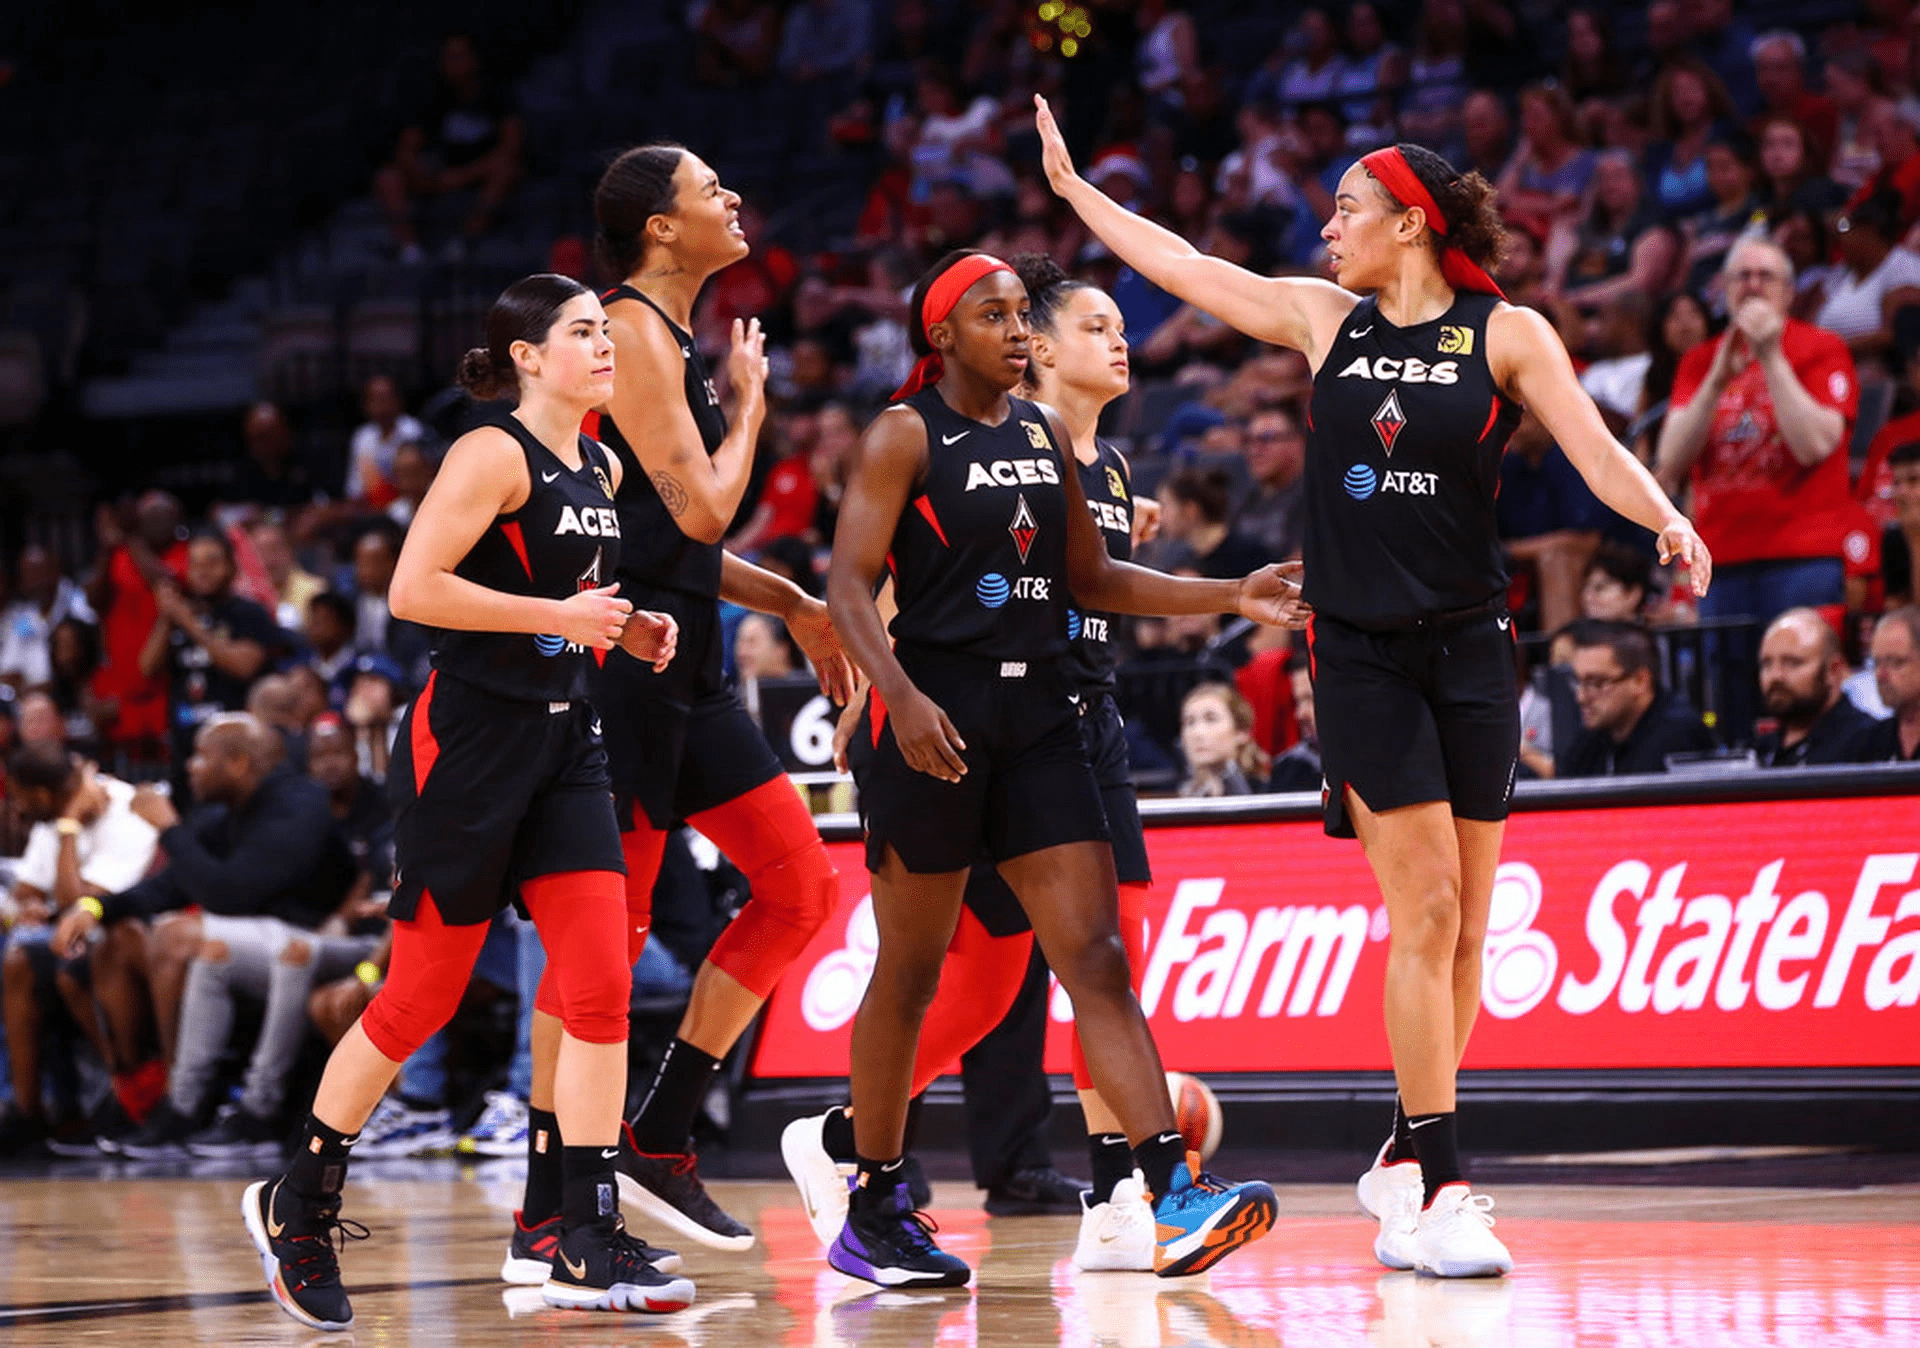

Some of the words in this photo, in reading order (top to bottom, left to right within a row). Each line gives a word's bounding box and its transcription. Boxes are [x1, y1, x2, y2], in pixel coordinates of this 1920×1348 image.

[1337, 356, 1459, 385] ACES
[964, 458, 1060, 492] ACES
[1381, 471, 1439, 496] AT&T
[1086, 499, 1130, 534] CES
[1010, 577, 1051, 600] AT&
[1082, 616, 1108, 643] AT&
[790, 694, 834, 765] 6
